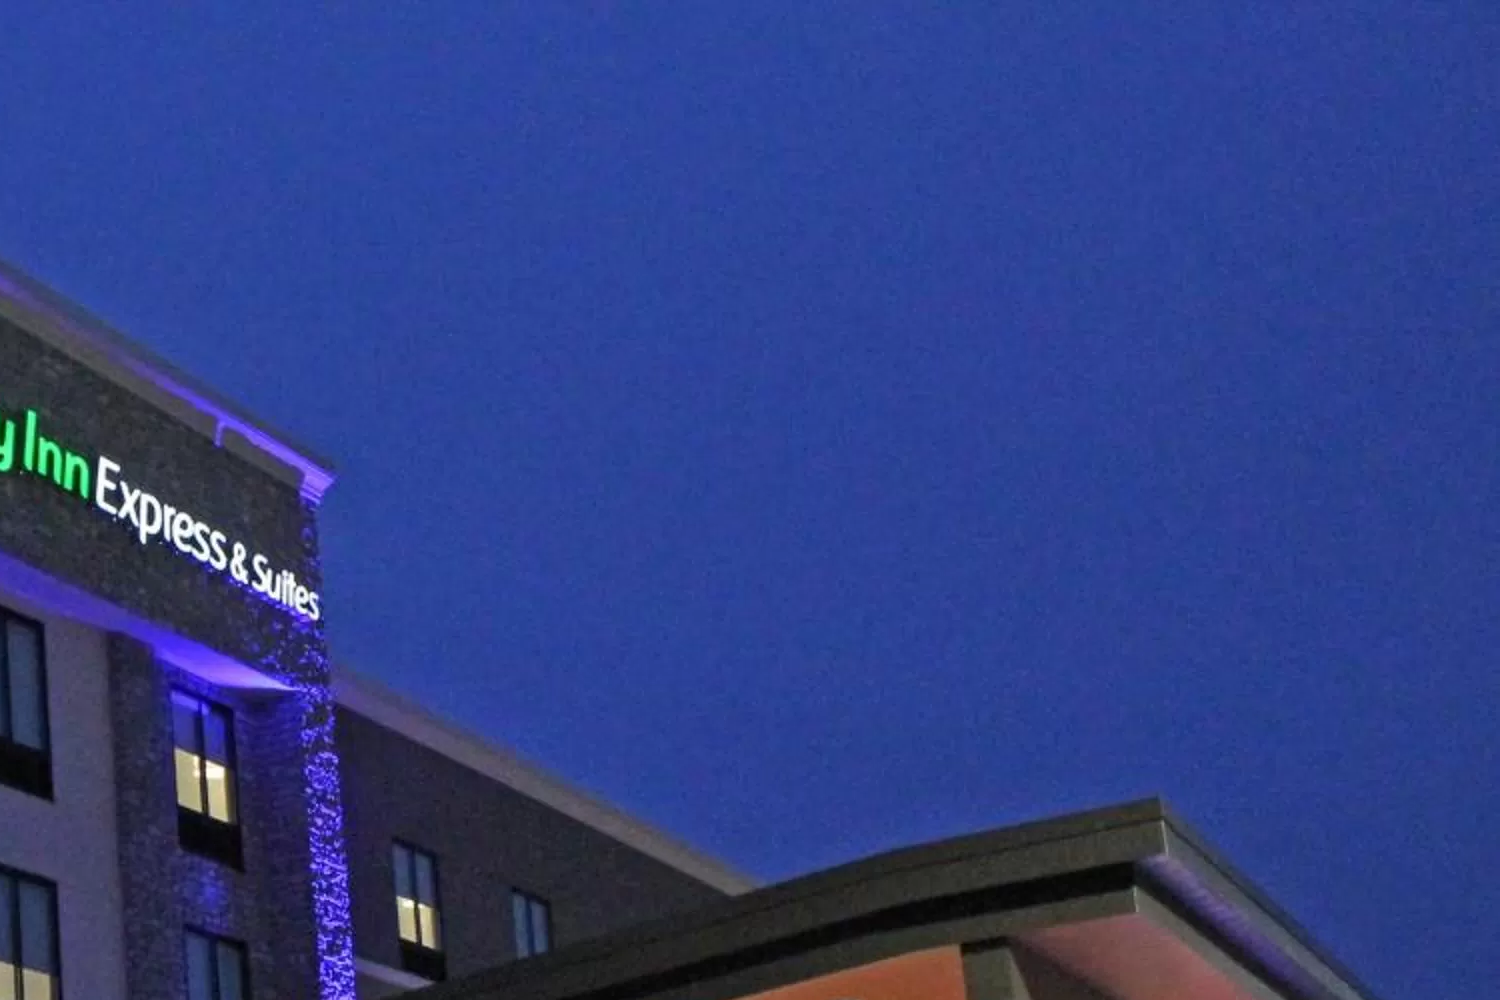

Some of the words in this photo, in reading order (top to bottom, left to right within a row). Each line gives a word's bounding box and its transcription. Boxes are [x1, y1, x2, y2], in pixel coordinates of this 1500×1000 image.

[22, 411, 91, 501] Inn
[95, 455, 228, 574] Express
[229, 541, 250, 587] &
[252, 553, 321, 622] Suites
